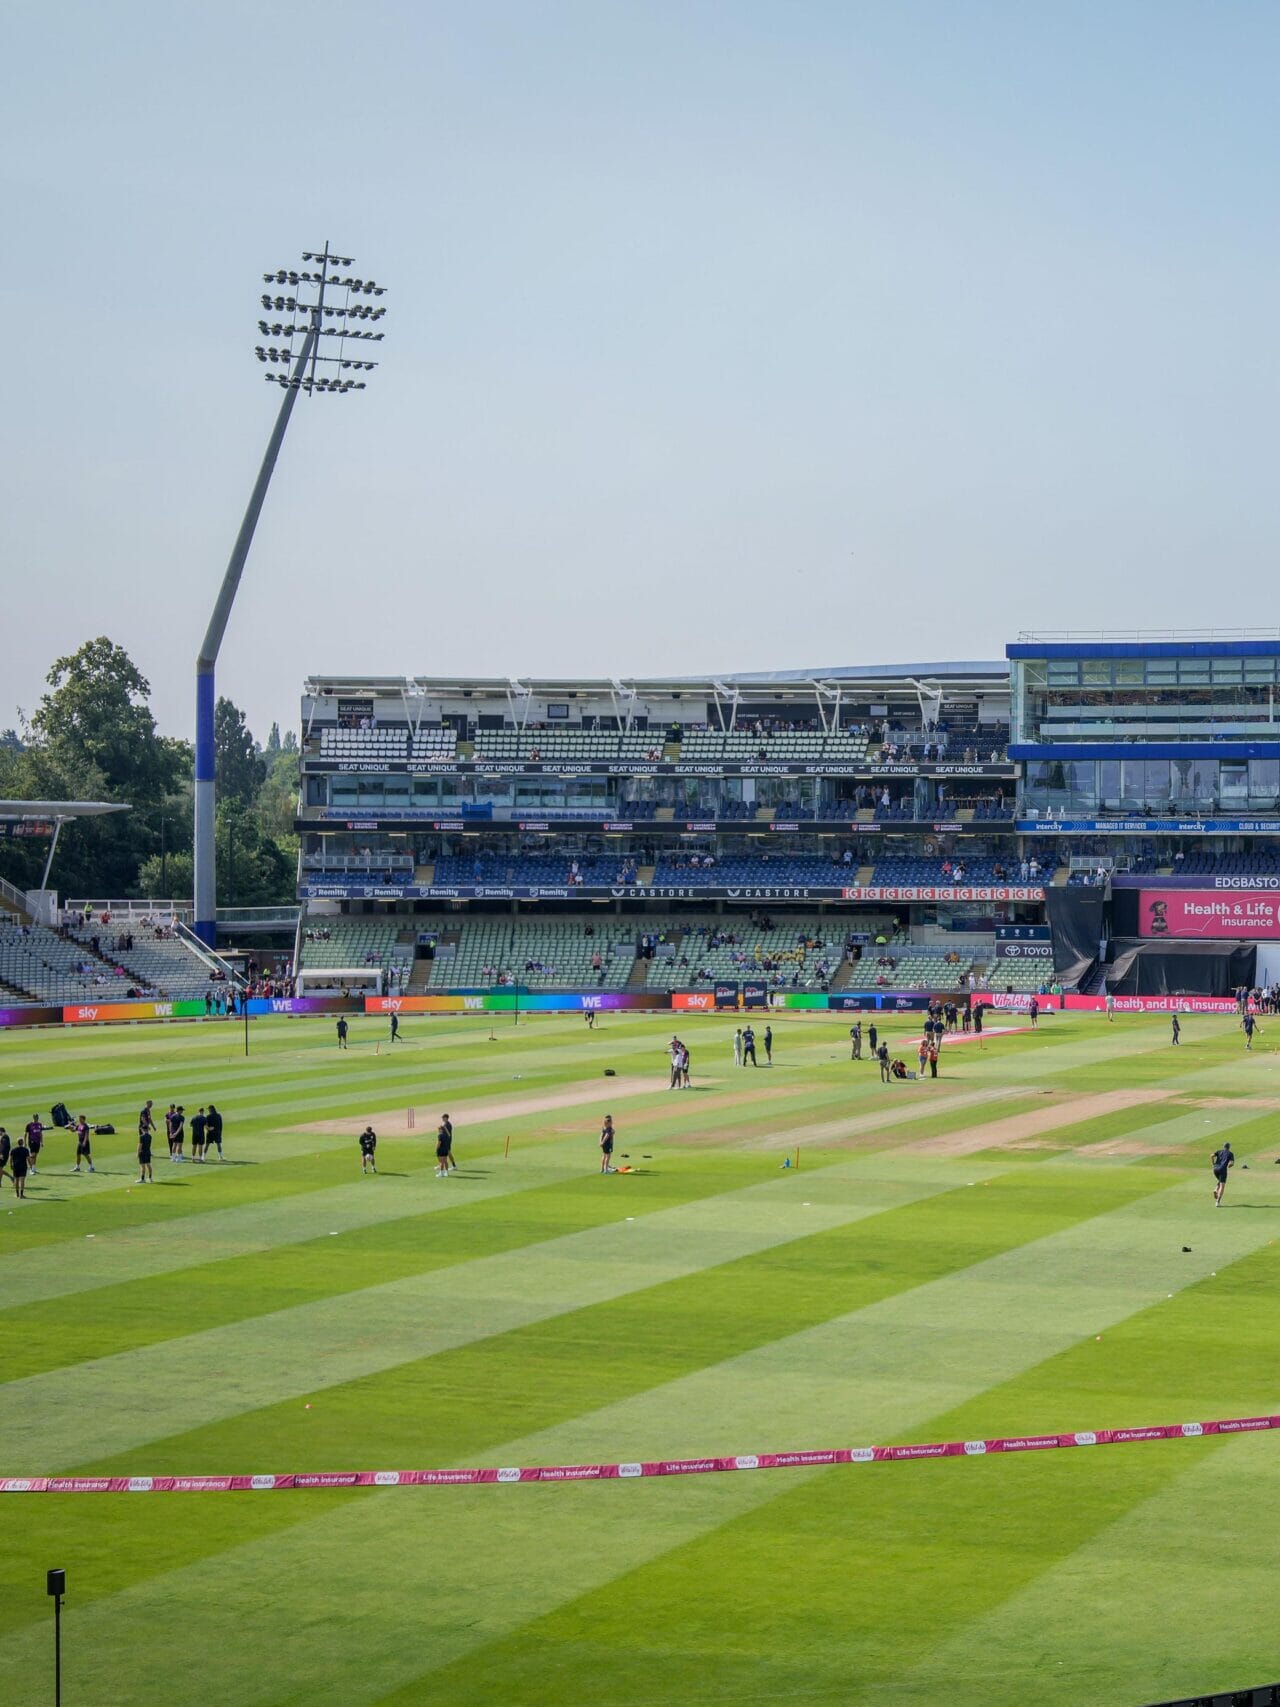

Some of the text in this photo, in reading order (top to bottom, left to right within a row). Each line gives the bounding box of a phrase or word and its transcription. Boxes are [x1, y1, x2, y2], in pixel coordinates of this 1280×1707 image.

[319, 888, 347, 897] Remitly
[375, 888, 403, 897] Remitly
[430, 888, 458, 897] Remitly
[485, 888, 513, 897] Remitly
[540, 888, 568, 897] Remitly
[630, 889, 693, 897] CASTORE
[746, 889, 808, 897] CASTORE
[1184, 903, 1273, 915] Health & Life
[1222, 917, 1273, 926] insurance
[272, 1000, 292, 1011] WE
[382, 998, 402, 1011] sky
[464, 997, 483, 1008] WE
[582, 996, 601, 1007] WE
[688, 995, 707, 1007] sky
[1146, 1000, 1165, 1009] and
[1168, 999, 1191, 1009] Life
[78, 1008, 98, 1020] sky
[154, 1004, 173, 1015] WE
